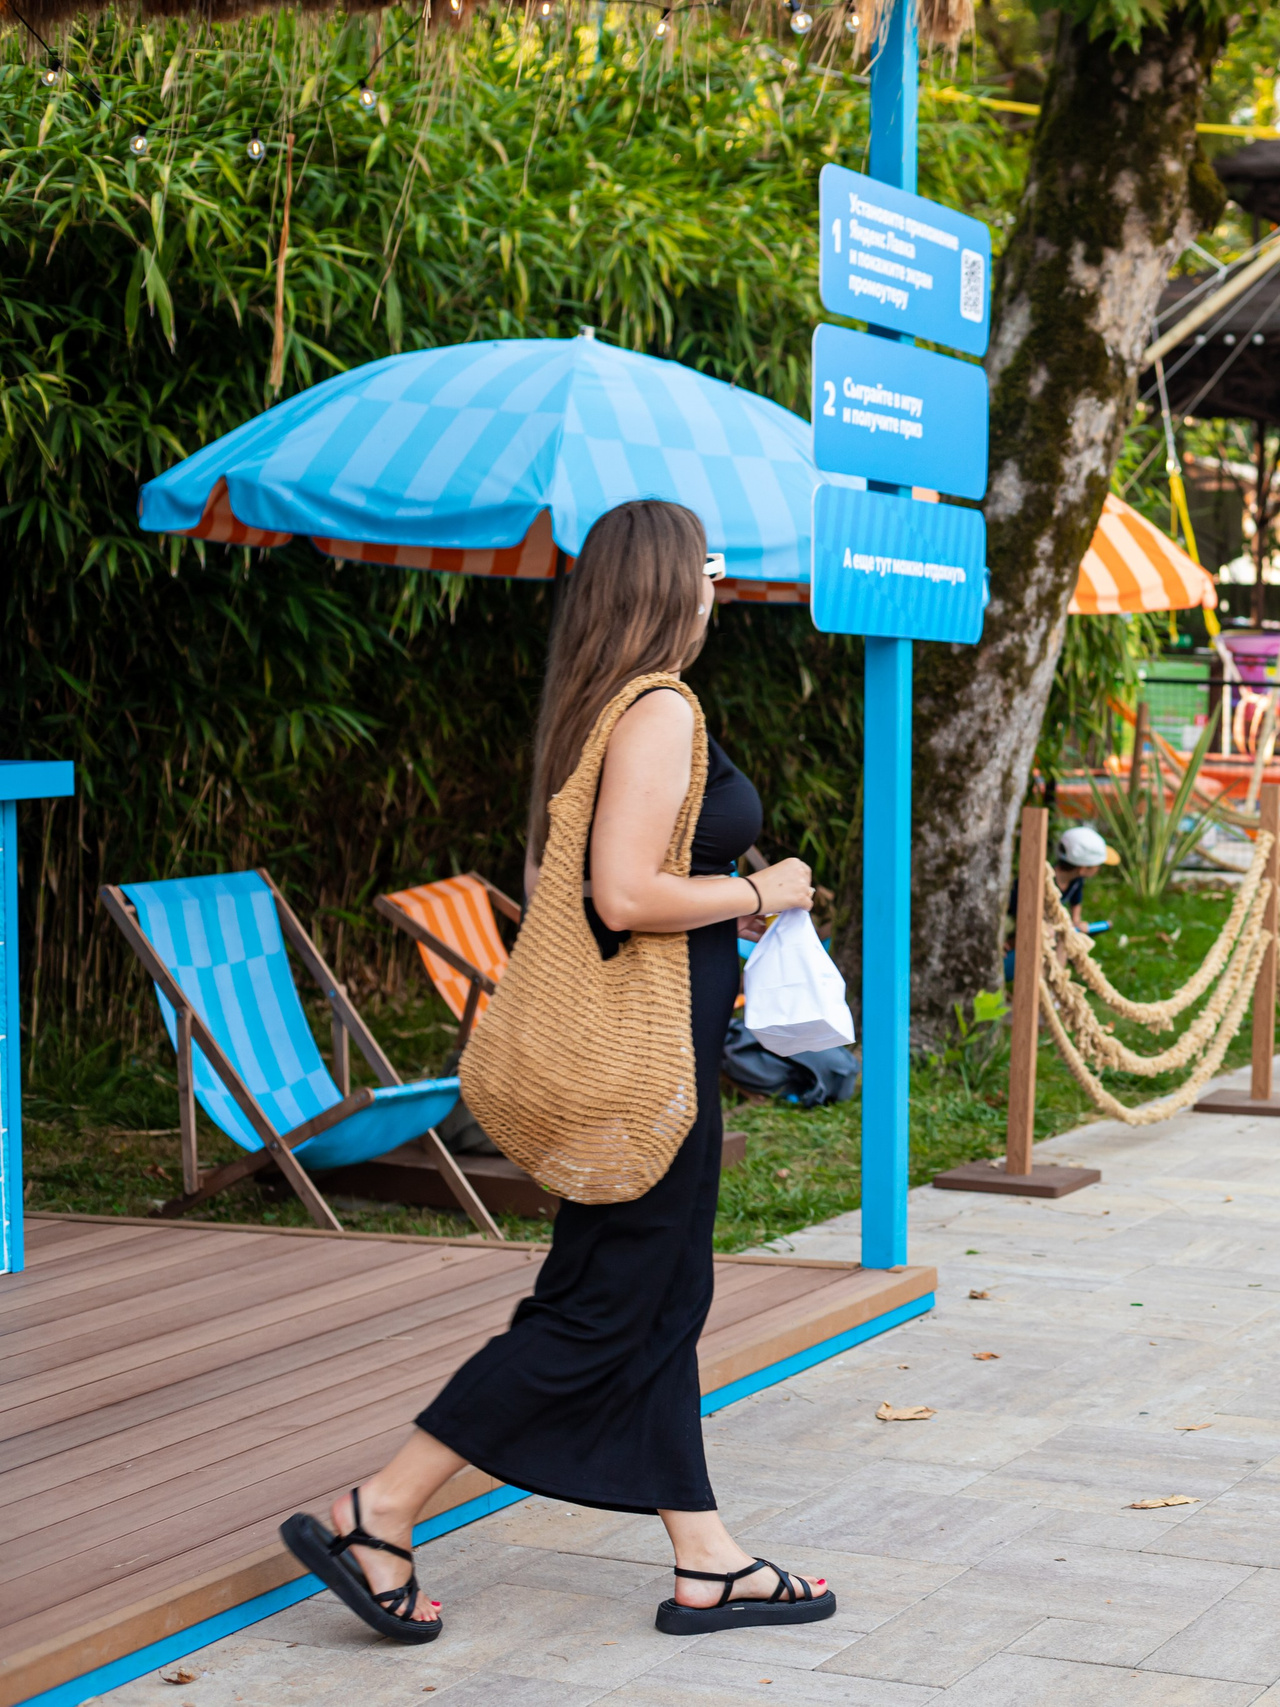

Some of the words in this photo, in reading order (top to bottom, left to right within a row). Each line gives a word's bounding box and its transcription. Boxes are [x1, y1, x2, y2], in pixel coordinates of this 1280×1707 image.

[832, 218, 841, 253] 1
[823, 380, 836, 417] 2
[843, 376, 893, 407] Сыграйте
[894, 393, 900, 408] в
[901, 394, 923, 418] игру
[842, 407, 850, 424] и
[851, 409, 899, 433] получите
[899, 420, 923, 440] приз
[843, 547, 853, 568] А
[853, 553, 874, 574] еще
[875, 556, 891, 577] тут
[892, 558, 924, 577] можно
[924, 562, 966, 586] отдохнуть
